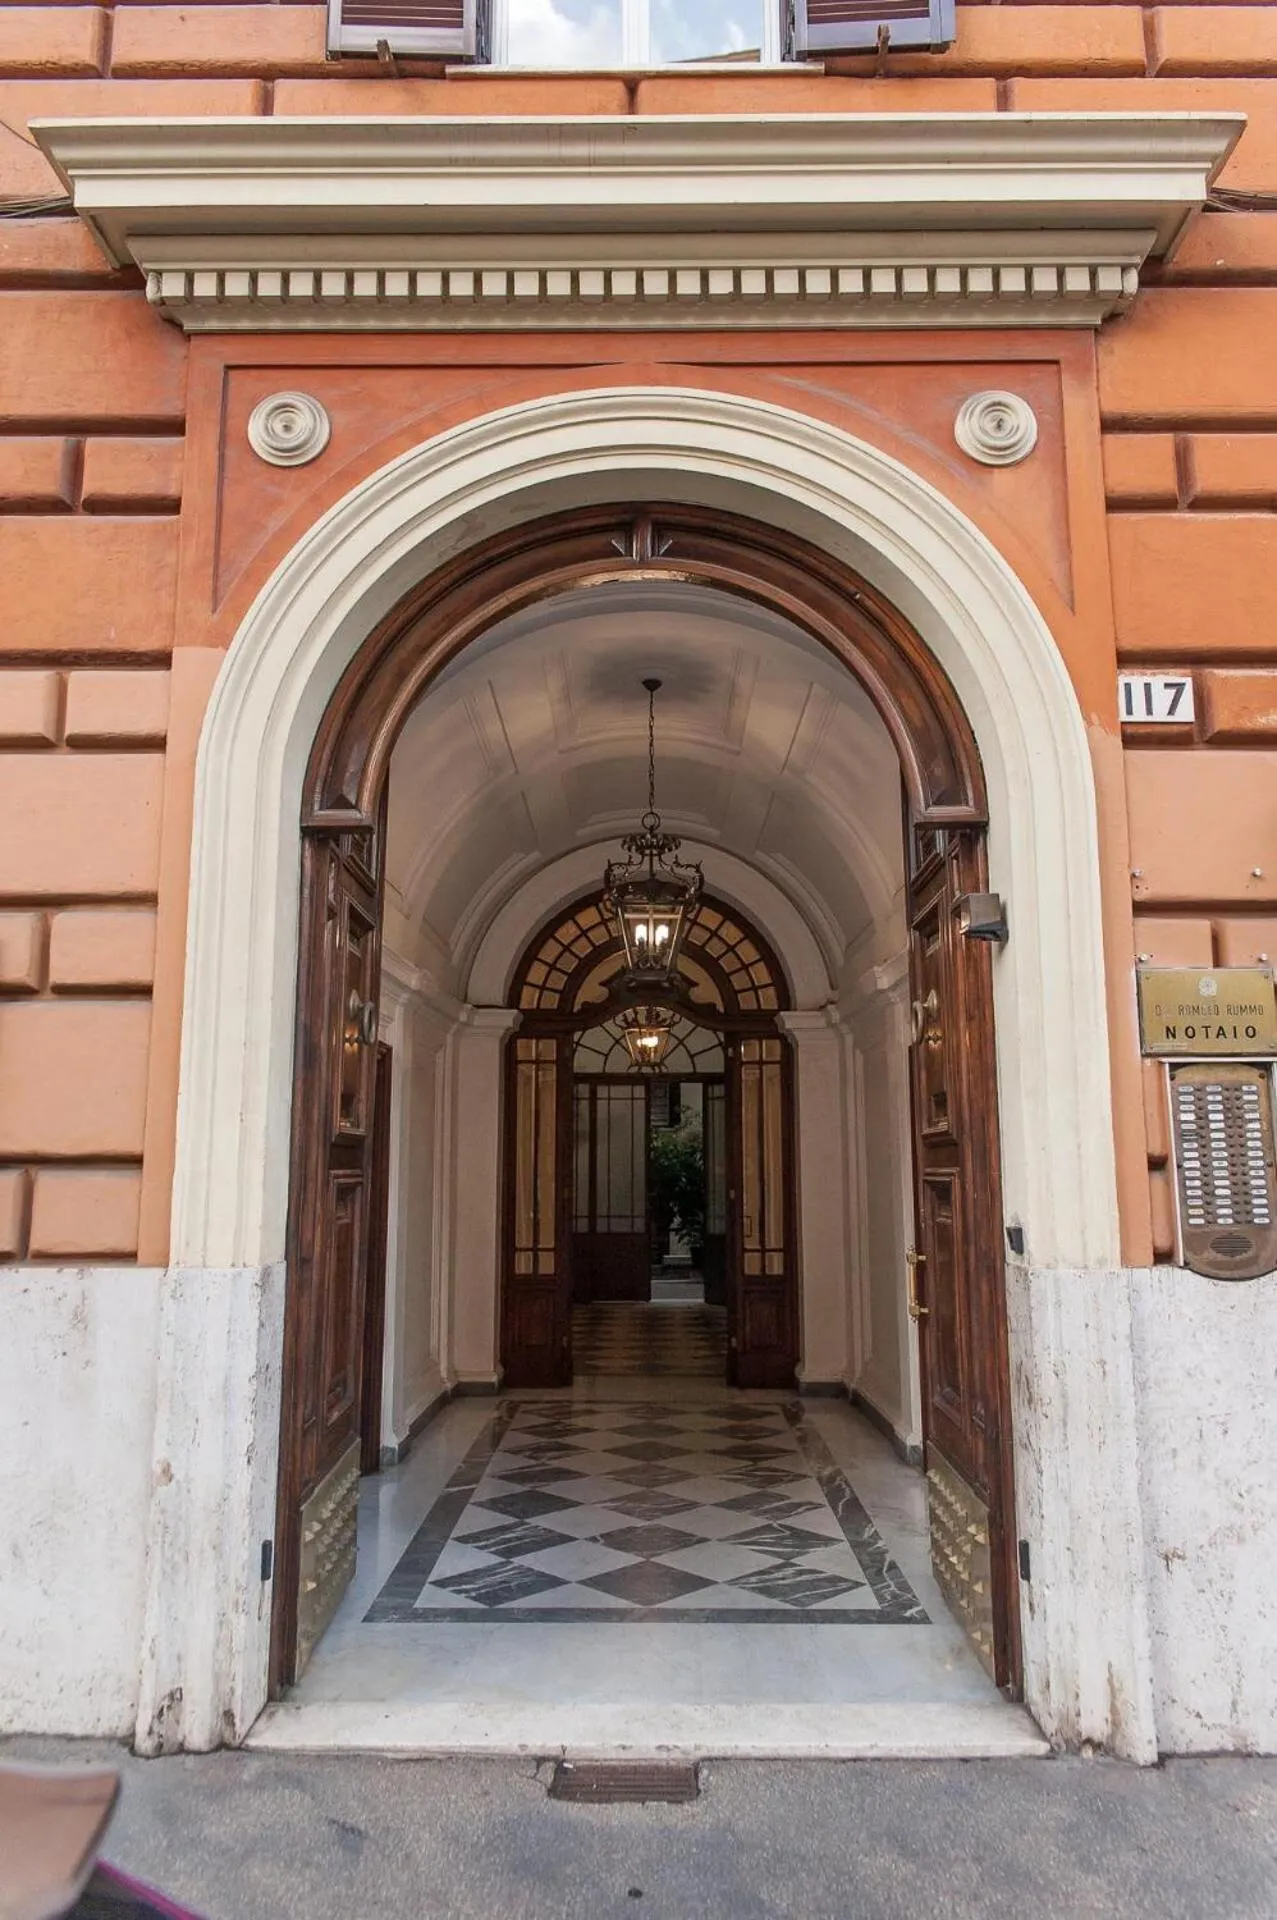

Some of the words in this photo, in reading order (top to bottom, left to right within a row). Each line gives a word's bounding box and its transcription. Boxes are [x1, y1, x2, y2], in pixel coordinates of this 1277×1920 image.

[1124, 682, 1187, 716] 117
[1226, 1003, 1264, 1016] RUMMO
[1165, 1025, 1257, 1039] NOTAIO
